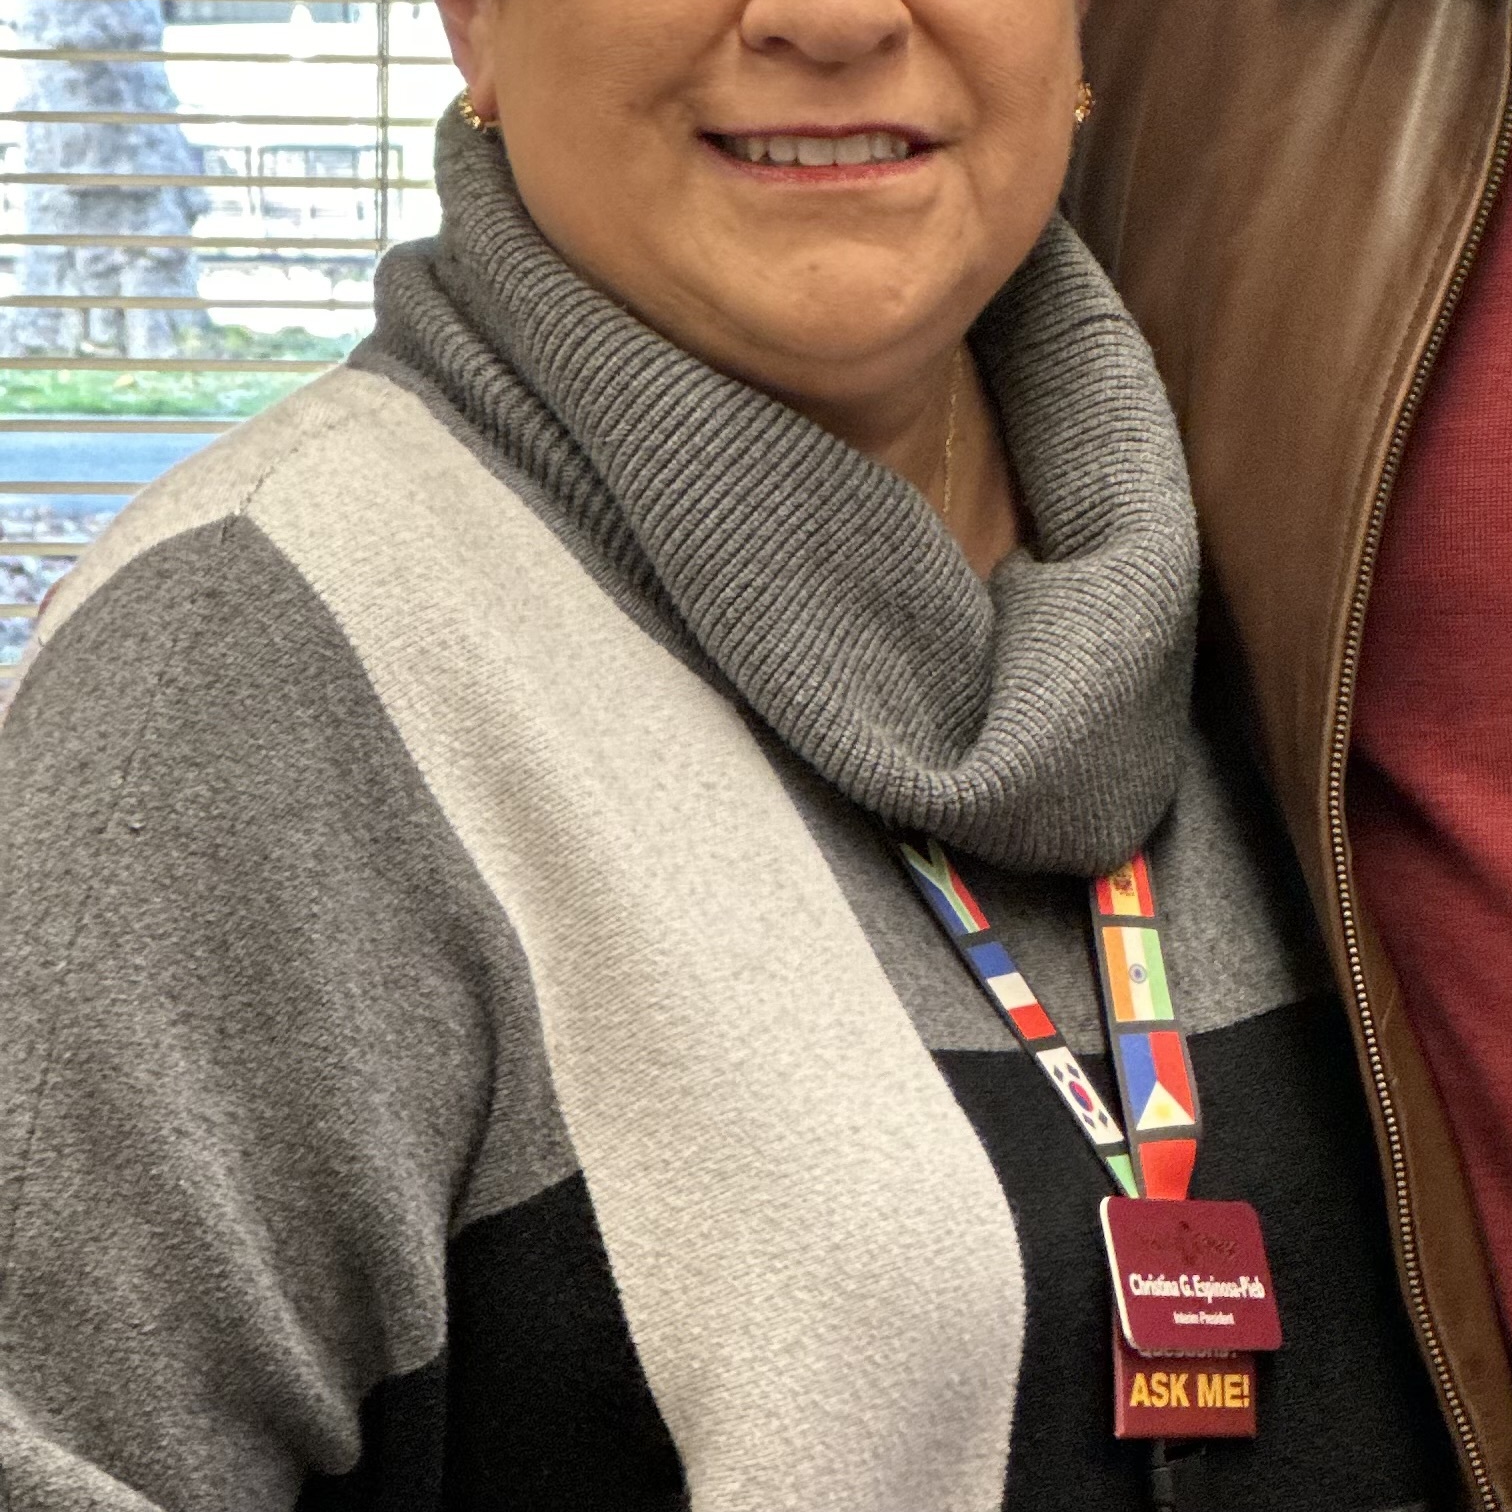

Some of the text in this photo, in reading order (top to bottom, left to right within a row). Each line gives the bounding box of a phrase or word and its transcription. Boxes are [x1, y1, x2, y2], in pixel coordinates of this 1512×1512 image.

[1129, 1272, 1180, 1297] Christina
[1130, 1372, 1250, 1408] ASK ME!
